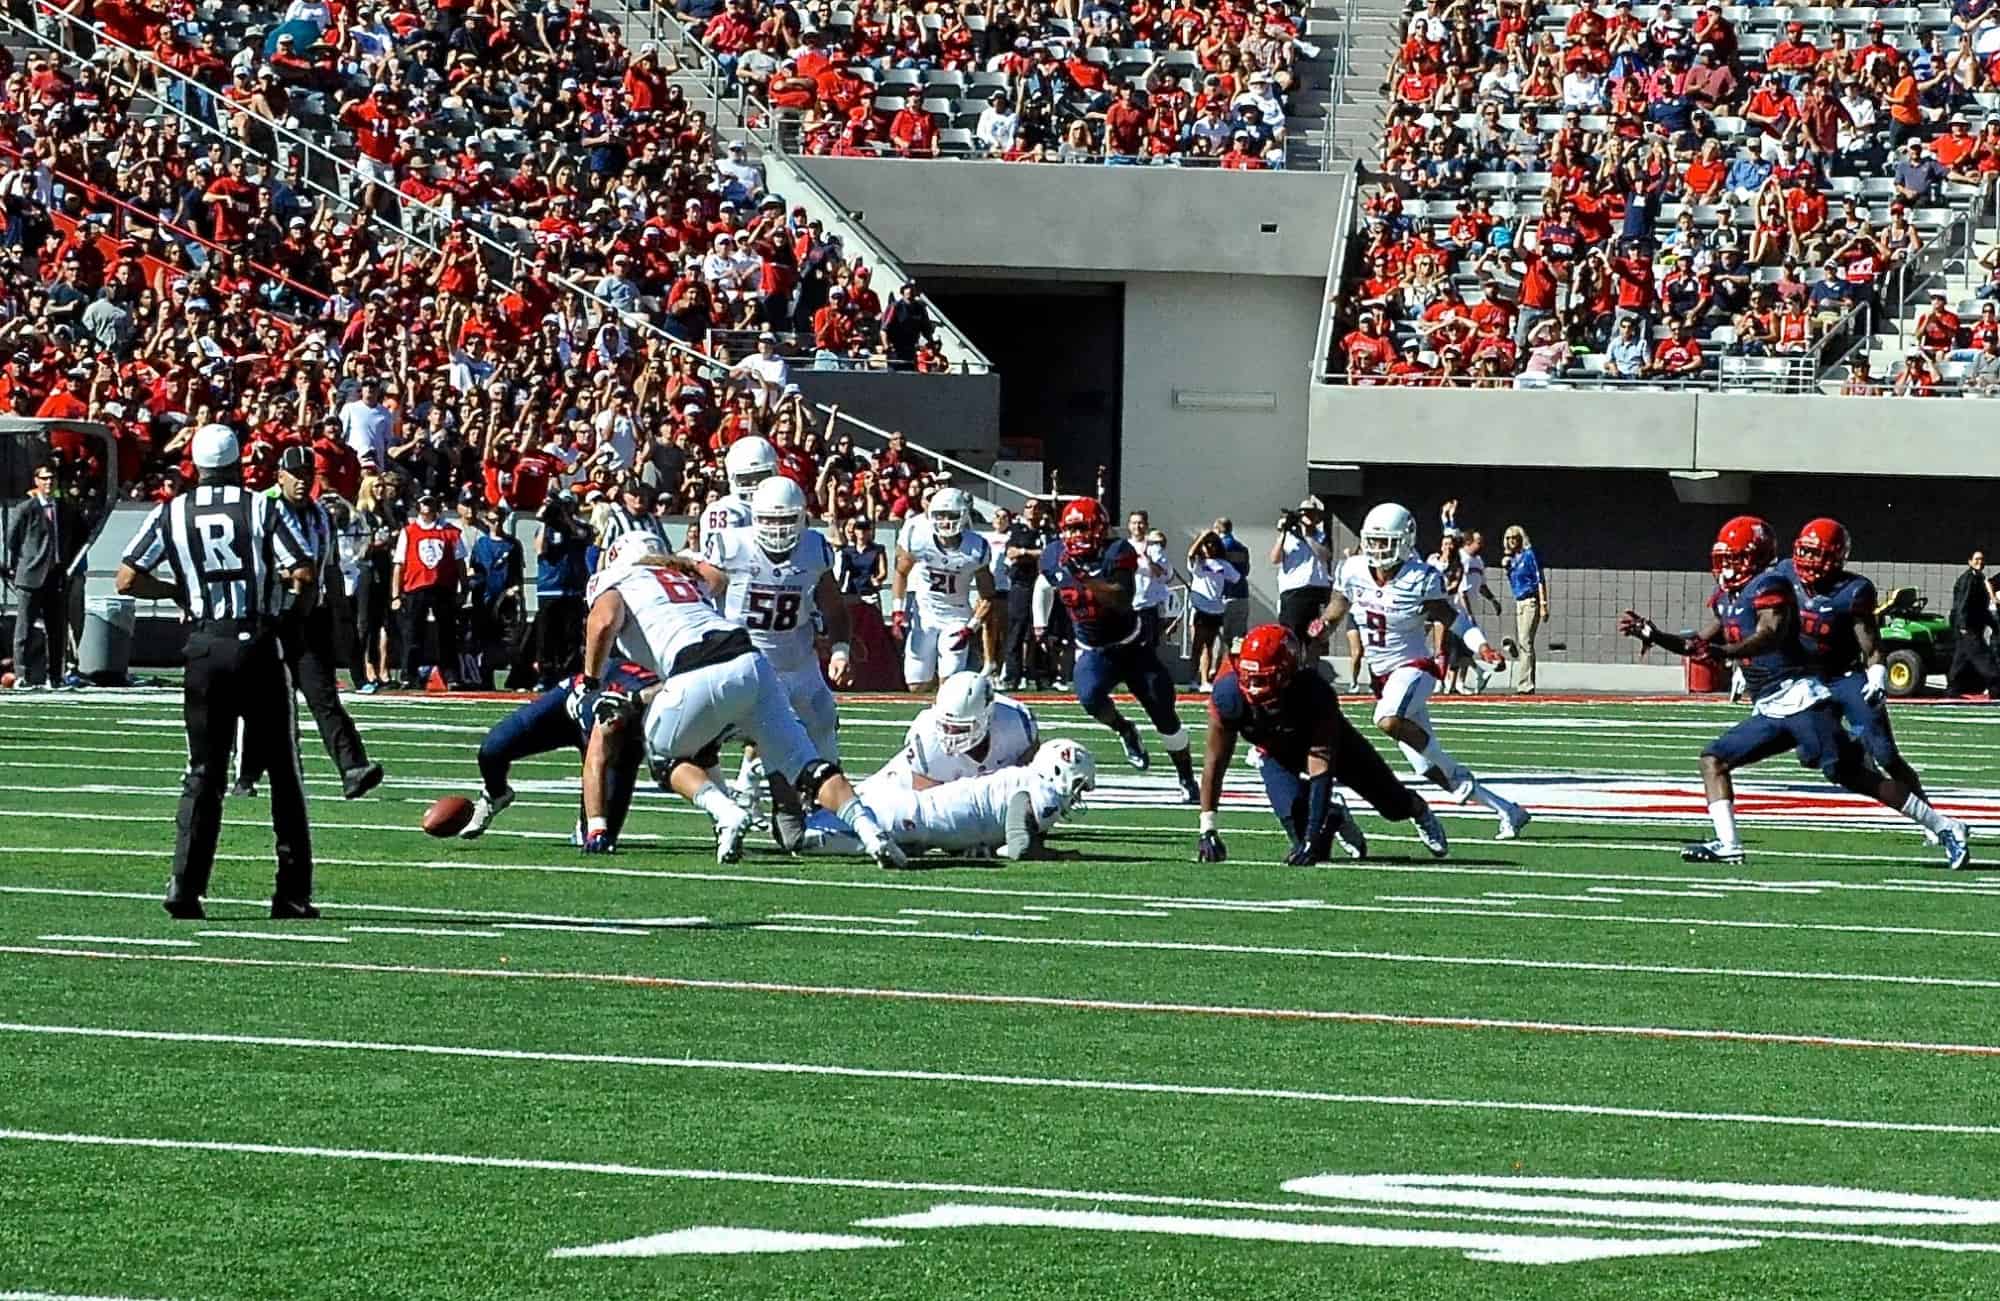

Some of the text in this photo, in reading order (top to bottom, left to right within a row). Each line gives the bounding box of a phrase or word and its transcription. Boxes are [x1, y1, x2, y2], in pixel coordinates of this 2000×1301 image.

[709, 510, 728, 529] 63
[194, 512, 243, 573] R
[930, 571, 957, 594] 21
[746, 591, 801, 631] 58
[1366, 610, 1387, 648] 9
